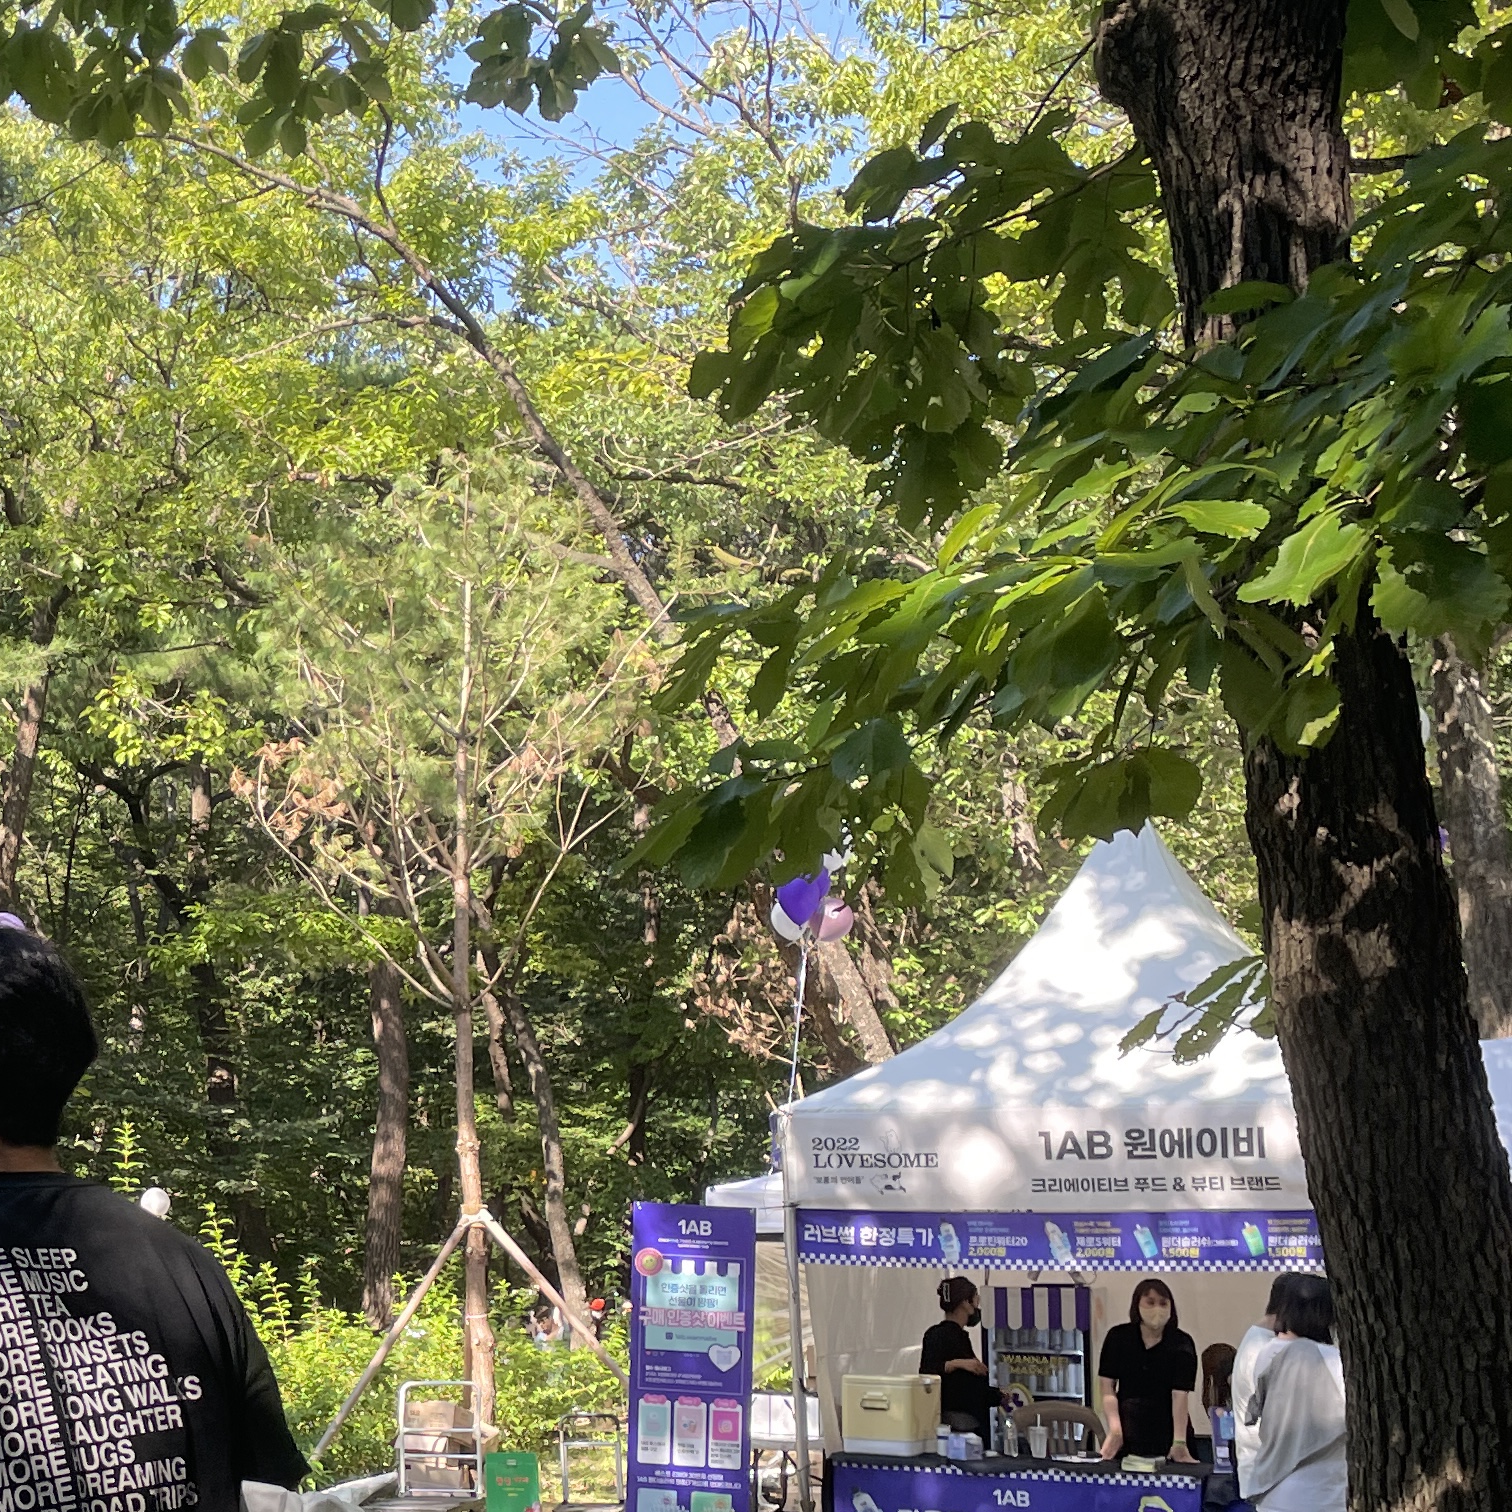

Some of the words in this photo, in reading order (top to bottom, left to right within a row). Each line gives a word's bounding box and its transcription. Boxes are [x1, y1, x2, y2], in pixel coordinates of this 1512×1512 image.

[811, 1136, 860, 1152] 2022
[1037, 1129, 1114, 1161] 1AB
[1123, 1126, 1267, 1161] 원에이비
[813, 1152, 939, 1169] LOVESOME
[1031, 1176, 1130, 1193] 크리에이티브
[1134, 1176, 1168, 1193] 푸드
[1172, 1176, 1186, 1193] &
[1191, 1175, 1225, 1192] 뷰티
[1230, 1175, 1283, 1192] 브랜드
[677, 1218, 713, 1237] 1AB
[803, 1223, 855, 1246] 러브썸
[860, 1225, 934, 1247] 한정특가
[11, 1247, 77, 1269] SLEEP
[19, 1269, 88, 1293] MUSIC
[28, 1293, 71, 1317] TEA
[638, 1305, 666, 1327] 구매
[667, 1308, 707, 1329] 인증샷
[707, 1310, 746, 1333] 이벤트
[38, 1311, 117, 1343] BOOKS
[46, 1330, 150, 1368] SUNSETS
[52, 1353, 169, 1394] CREATING
[59, 1388, 124, 1420] LONG
[123, 1375, 203, 1409] WALKS
[65, 1404, 184, 1446] LAUGHTER
[72, 1438, 136, 1472] HUGS
[76, 1456, 187, 1500] DREAMING
[149, 1481, 199, 1512] TRIPS
[992, 1488, 1031, 1508] 1AB
